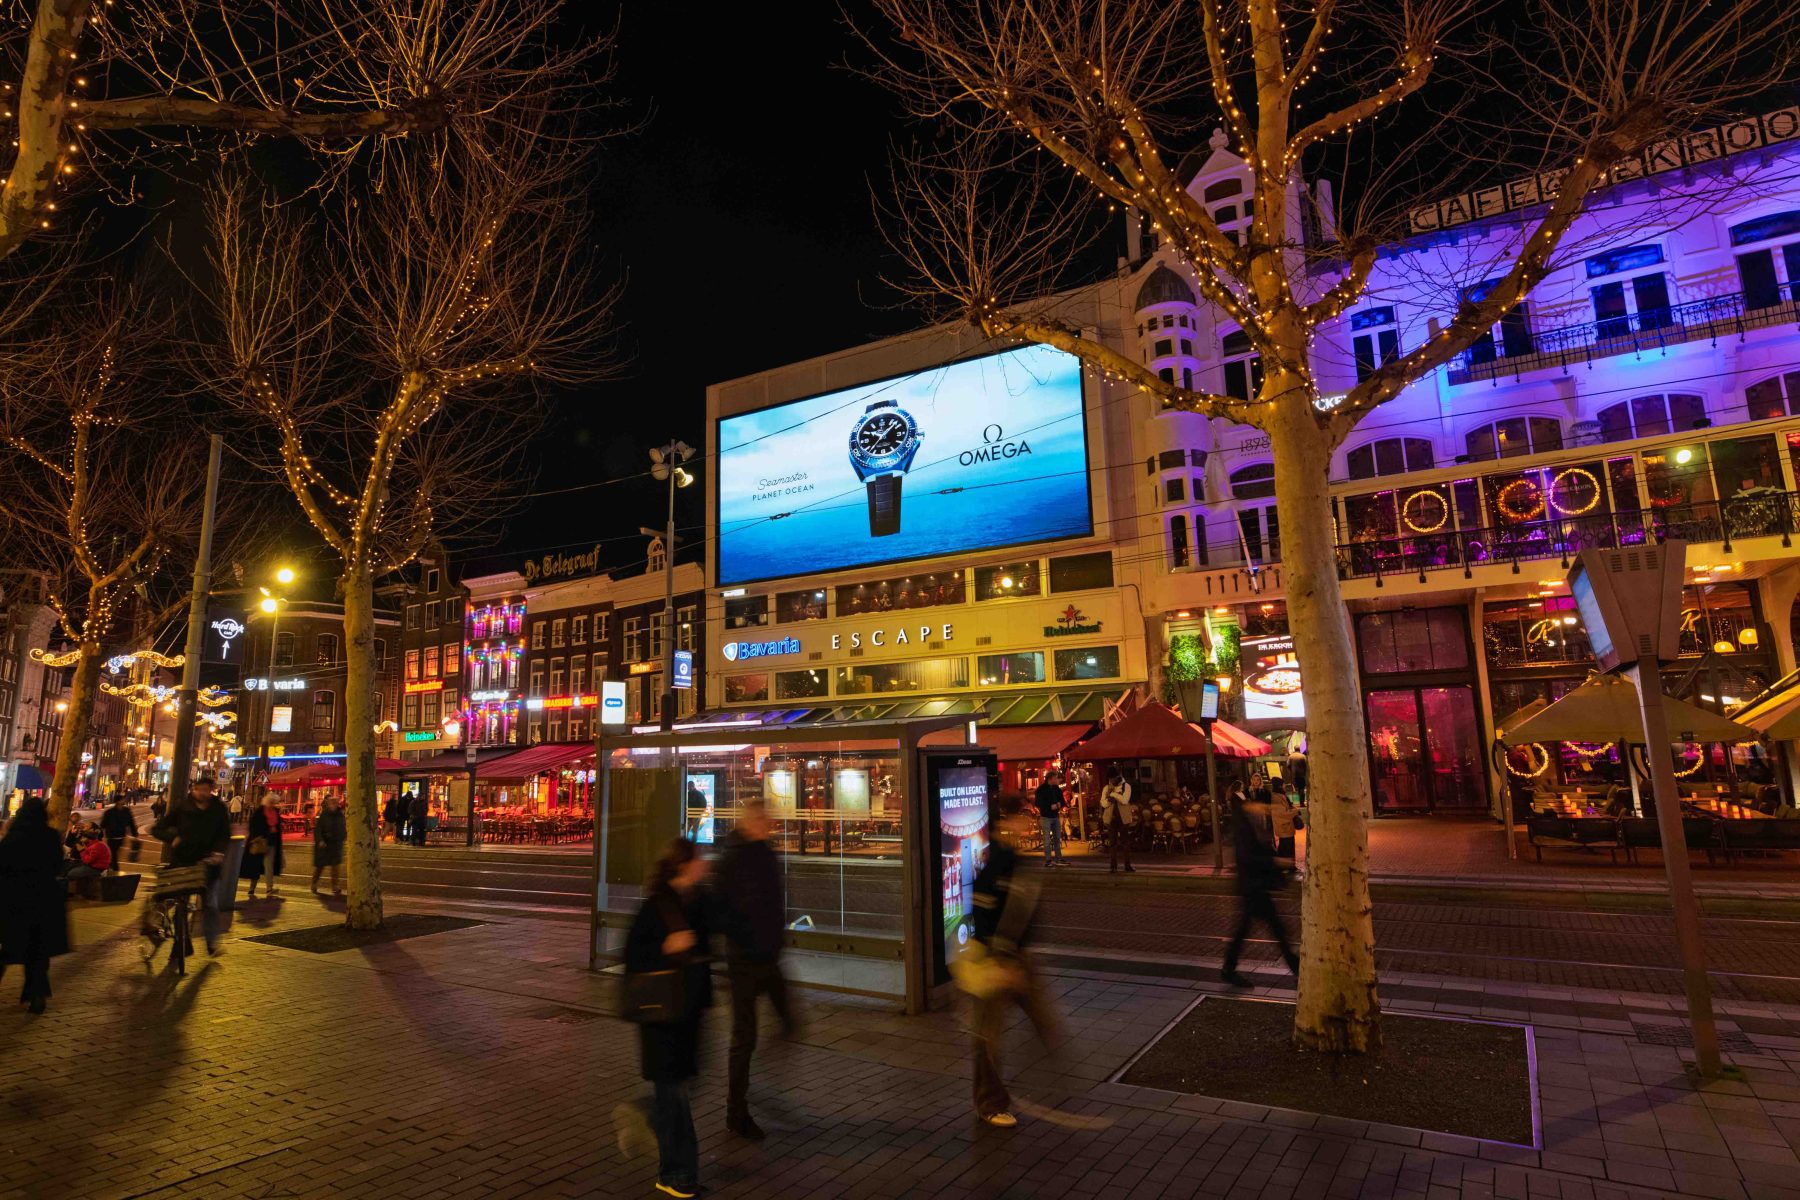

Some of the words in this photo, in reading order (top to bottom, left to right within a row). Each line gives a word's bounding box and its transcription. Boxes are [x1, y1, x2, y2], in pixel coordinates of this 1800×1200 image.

[1413, 180, 1528, 229] CAFE
[959, 440, 1032, 466] OMEGA
[757, 472, 808, 491] Seamaster
[752, 489, 782, 501] PLANET
[785, 484, 815, 495] OCEAN
[524, 559, 541, 581] De
[543, 544, 601, 576] Telegraaf
[831, 624, 953, 650] ESCAPE
[738, 635, 800, 660] Bavaria
[258, 678, 305, 690] Bvaria
[405, 731, 435, 743] Heineken
[318, 743, 335, 754] pub
[940, 788, 956, 798] BUILT
[957, 786, 965, 796] ON
[965, 785, 987, 795] LEGACY.
[944, 798, 961, 809] MADE
[961, 797, 968, 807] TO
[969, 796, 984, 806] LAST.
